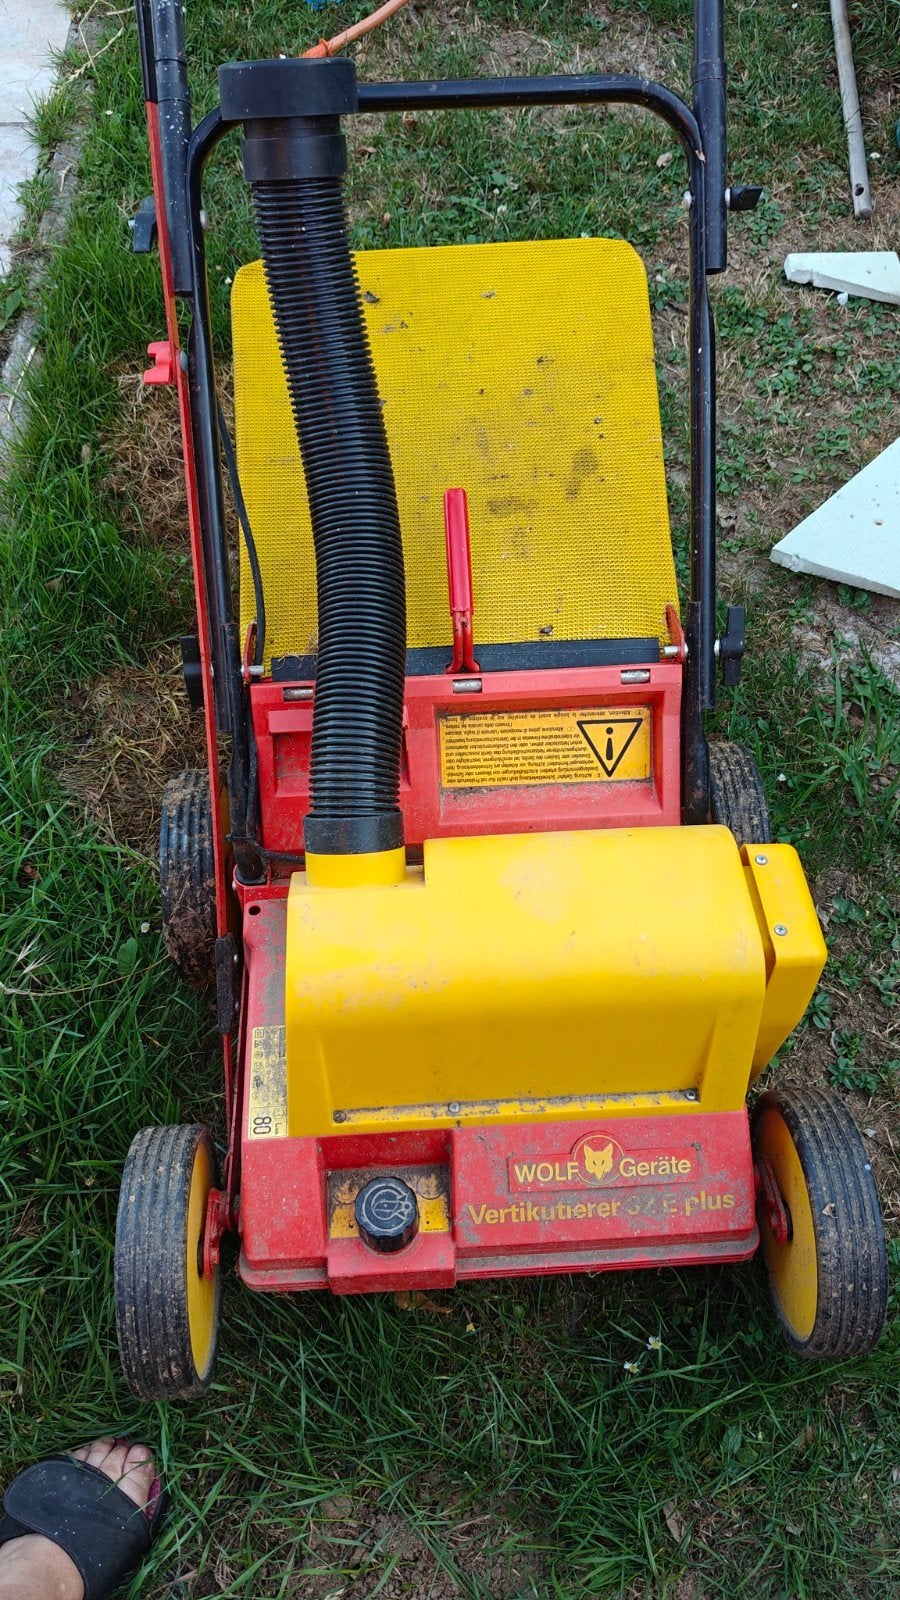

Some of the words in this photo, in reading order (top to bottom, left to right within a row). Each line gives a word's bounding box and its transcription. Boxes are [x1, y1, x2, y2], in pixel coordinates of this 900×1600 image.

[514, 1162, 579, 1183] WOLF
[619, 1156, 692, 1178] Geräte
[468, 1201, 621, 1225] Vertikutierer
[685, 1190, 735, 1216] plus
